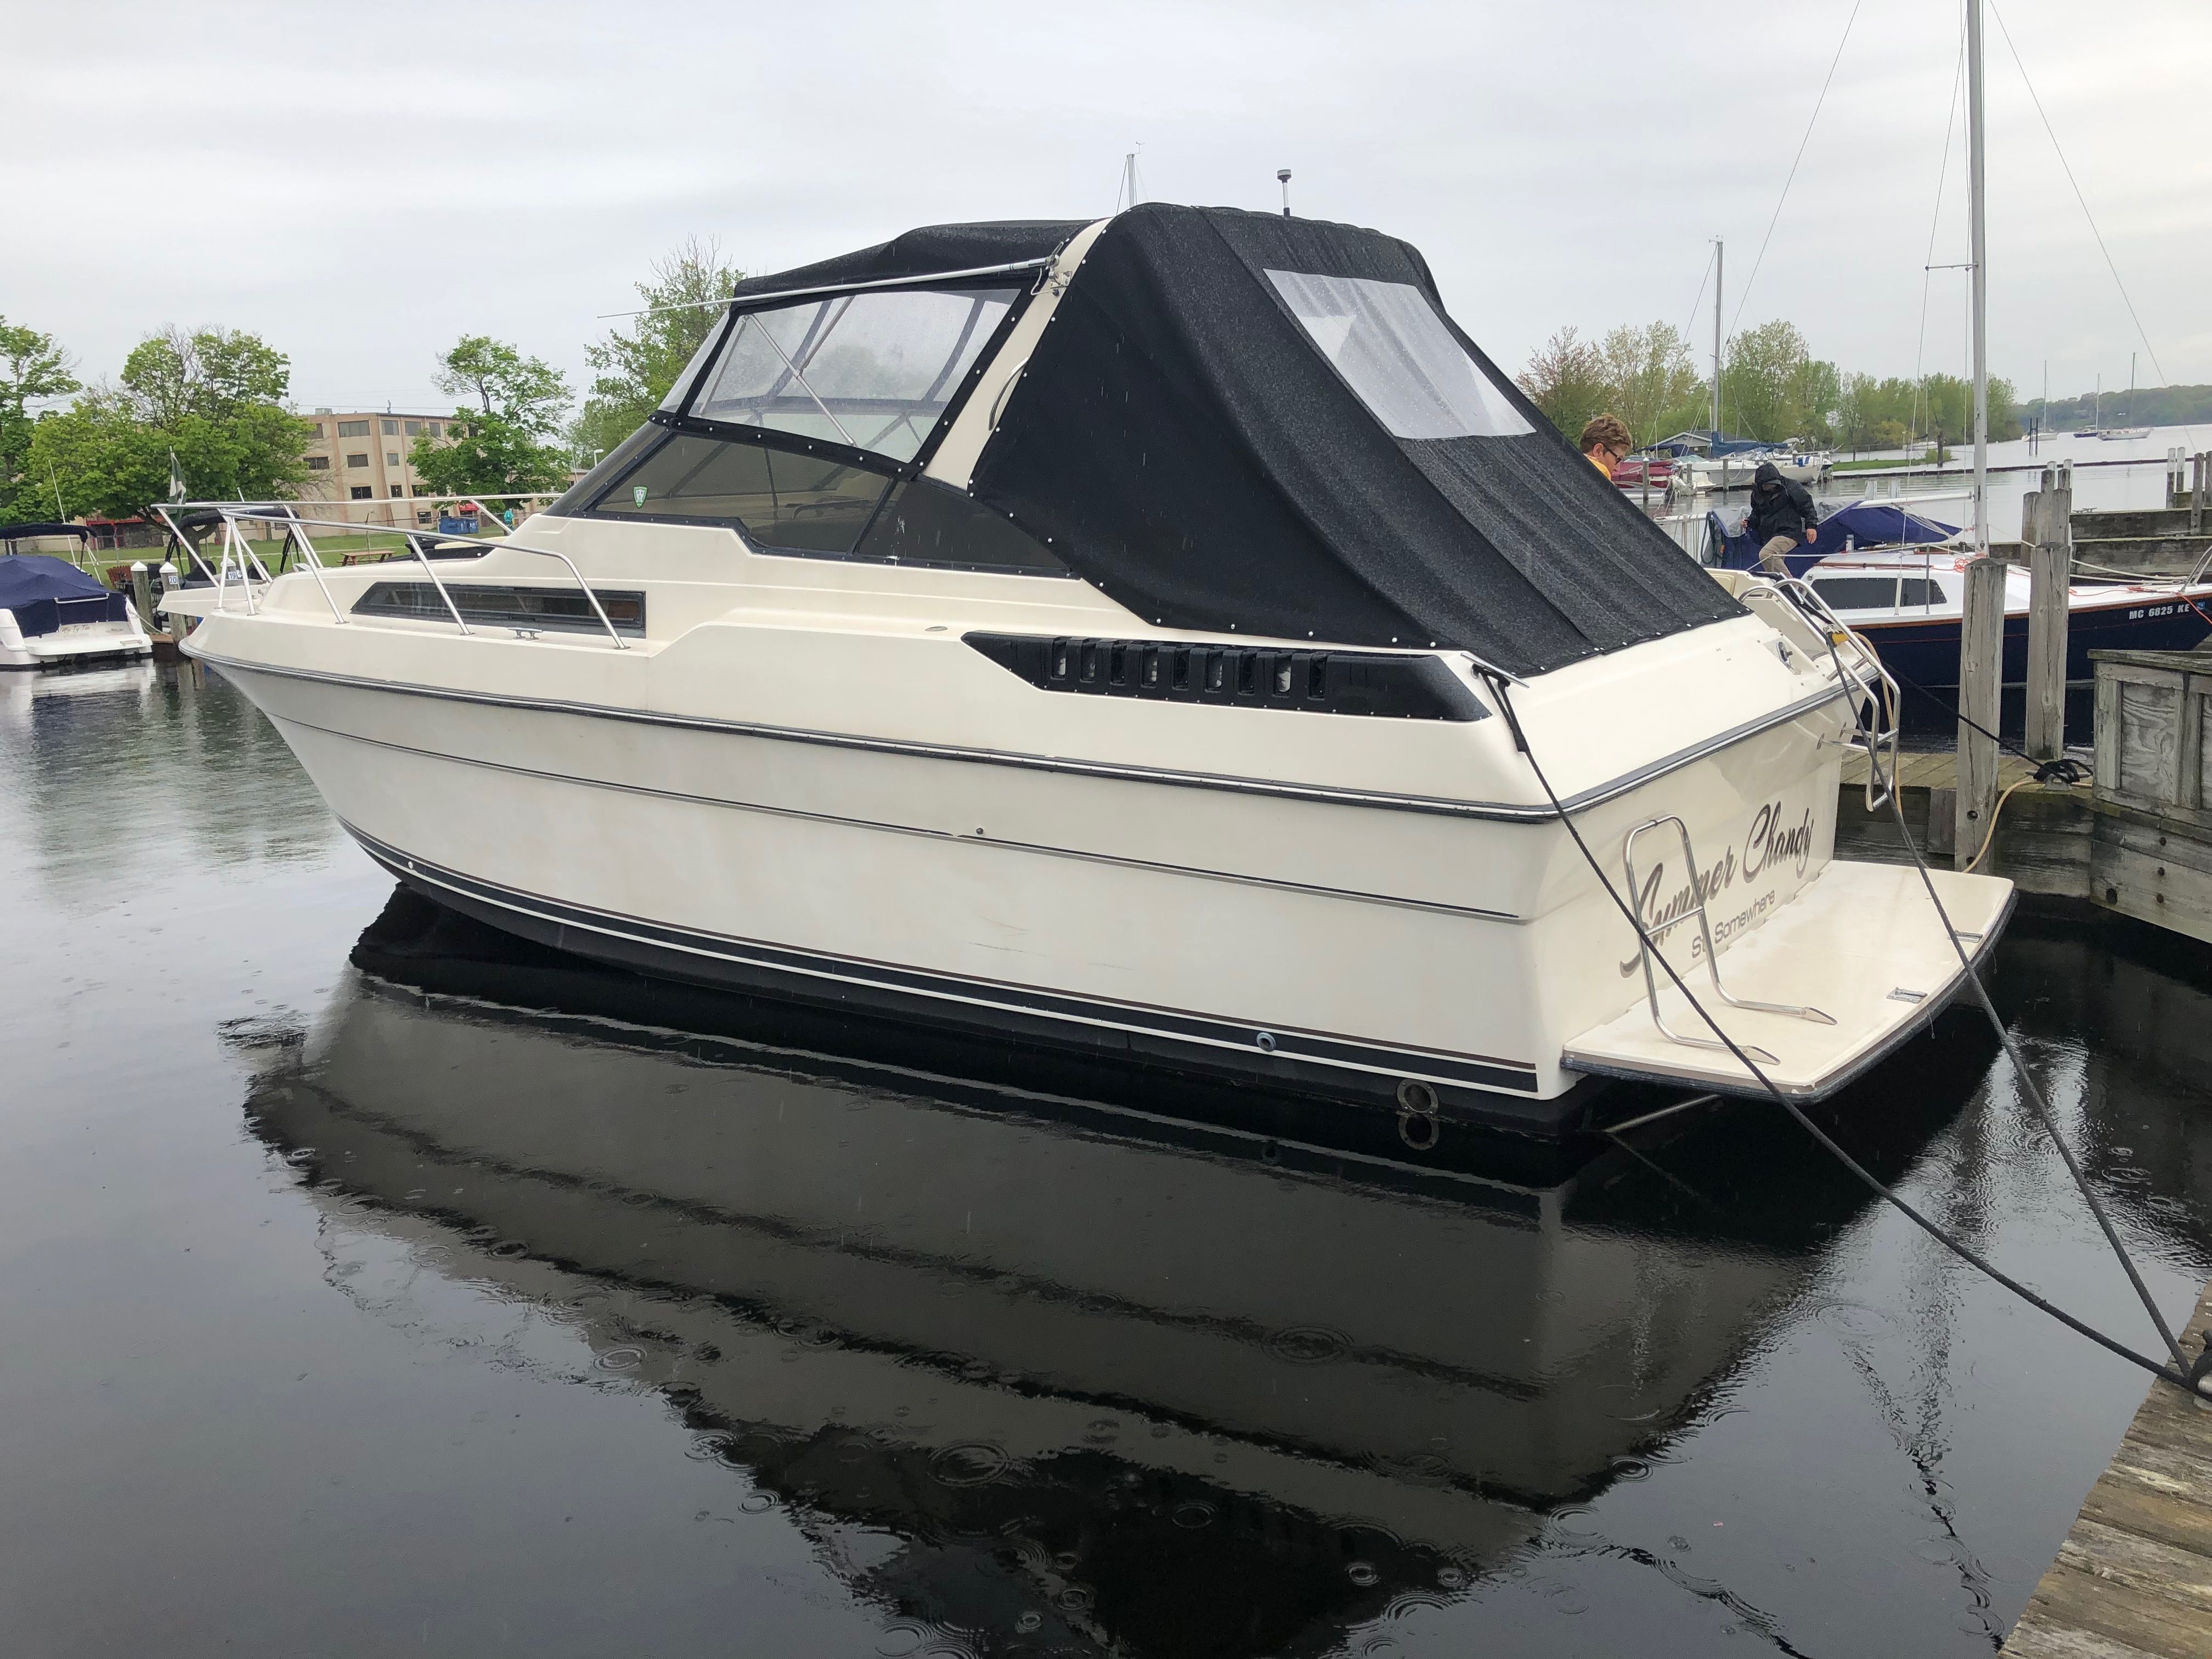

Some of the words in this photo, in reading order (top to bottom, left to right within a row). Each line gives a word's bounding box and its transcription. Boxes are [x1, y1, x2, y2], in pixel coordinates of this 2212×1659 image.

[2129, 610, 2144, 619] MC
[2177, 604, 2190, 613] KE
[1715, 890, 1775, 944] Somewhere
